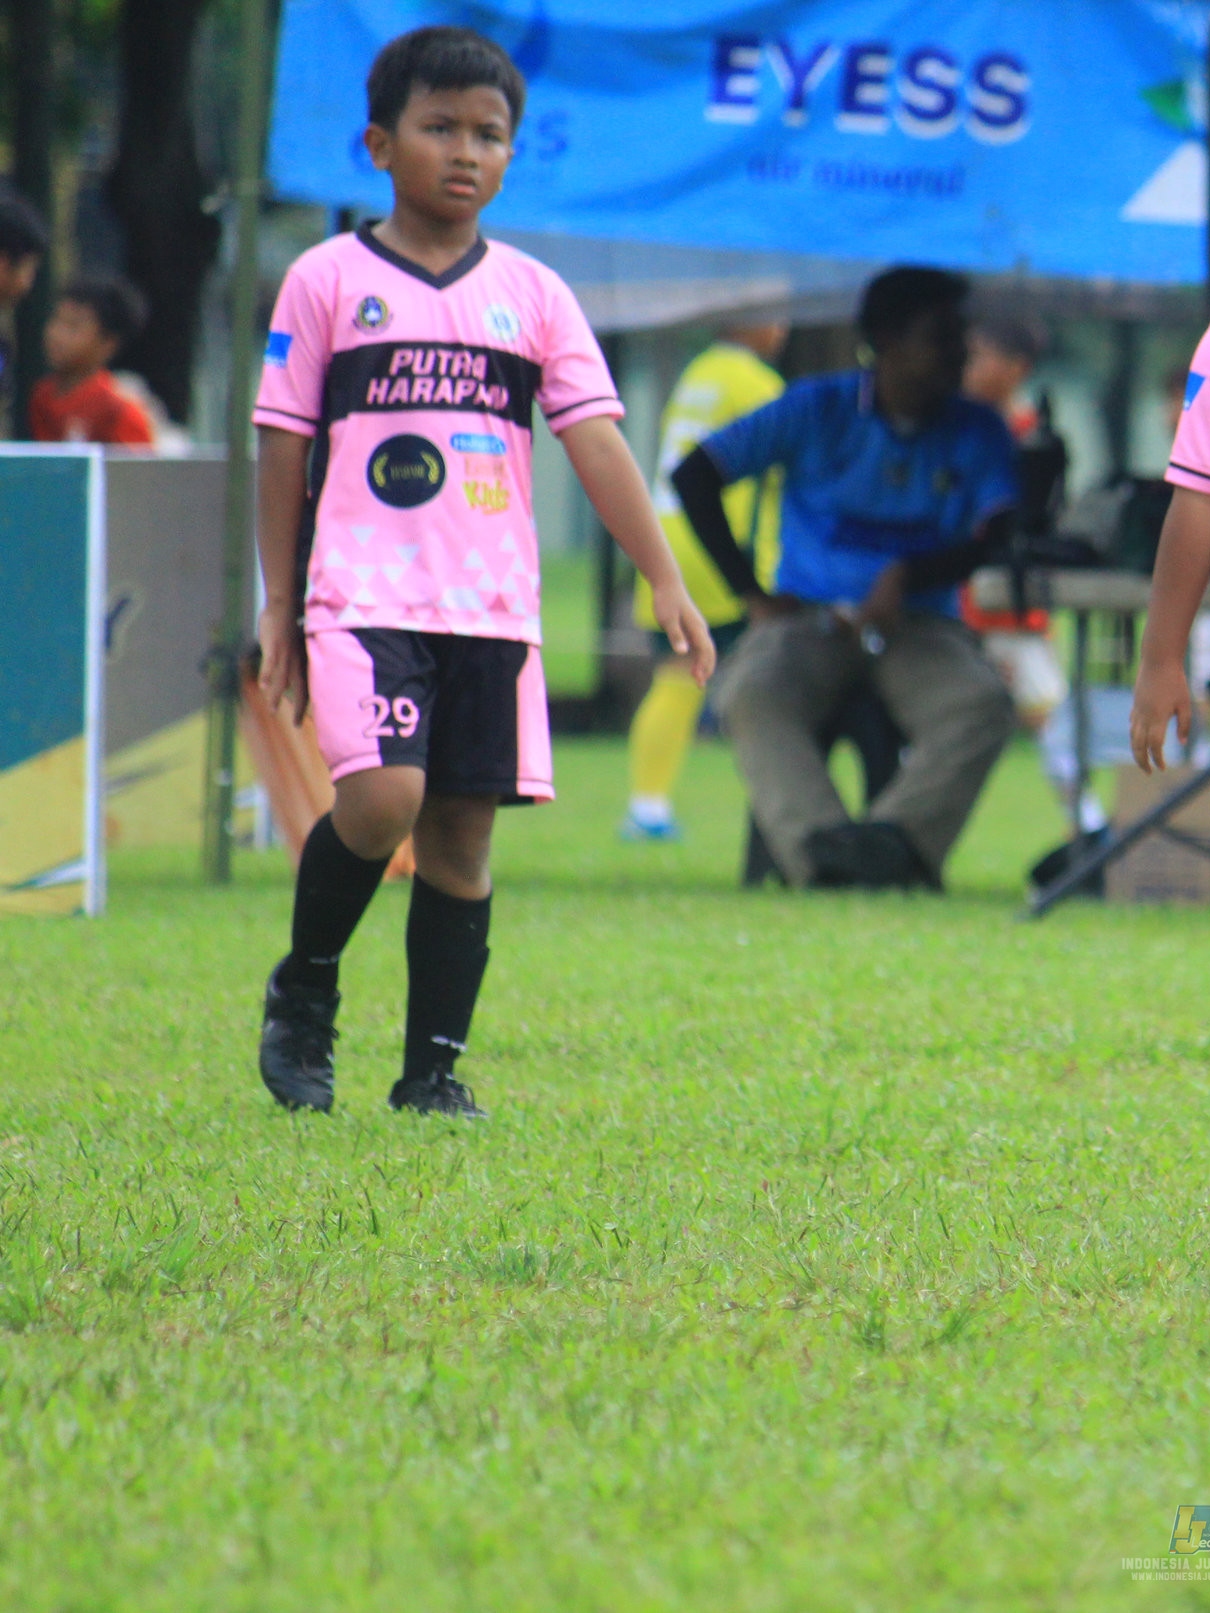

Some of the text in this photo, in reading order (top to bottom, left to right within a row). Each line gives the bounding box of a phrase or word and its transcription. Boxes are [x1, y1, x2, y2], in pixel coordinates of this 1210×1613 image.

[706, 37, 1030, 143] EYESS
[388, 348, 489, 382] PUTRA
[359, 694, 421, 739] 29
